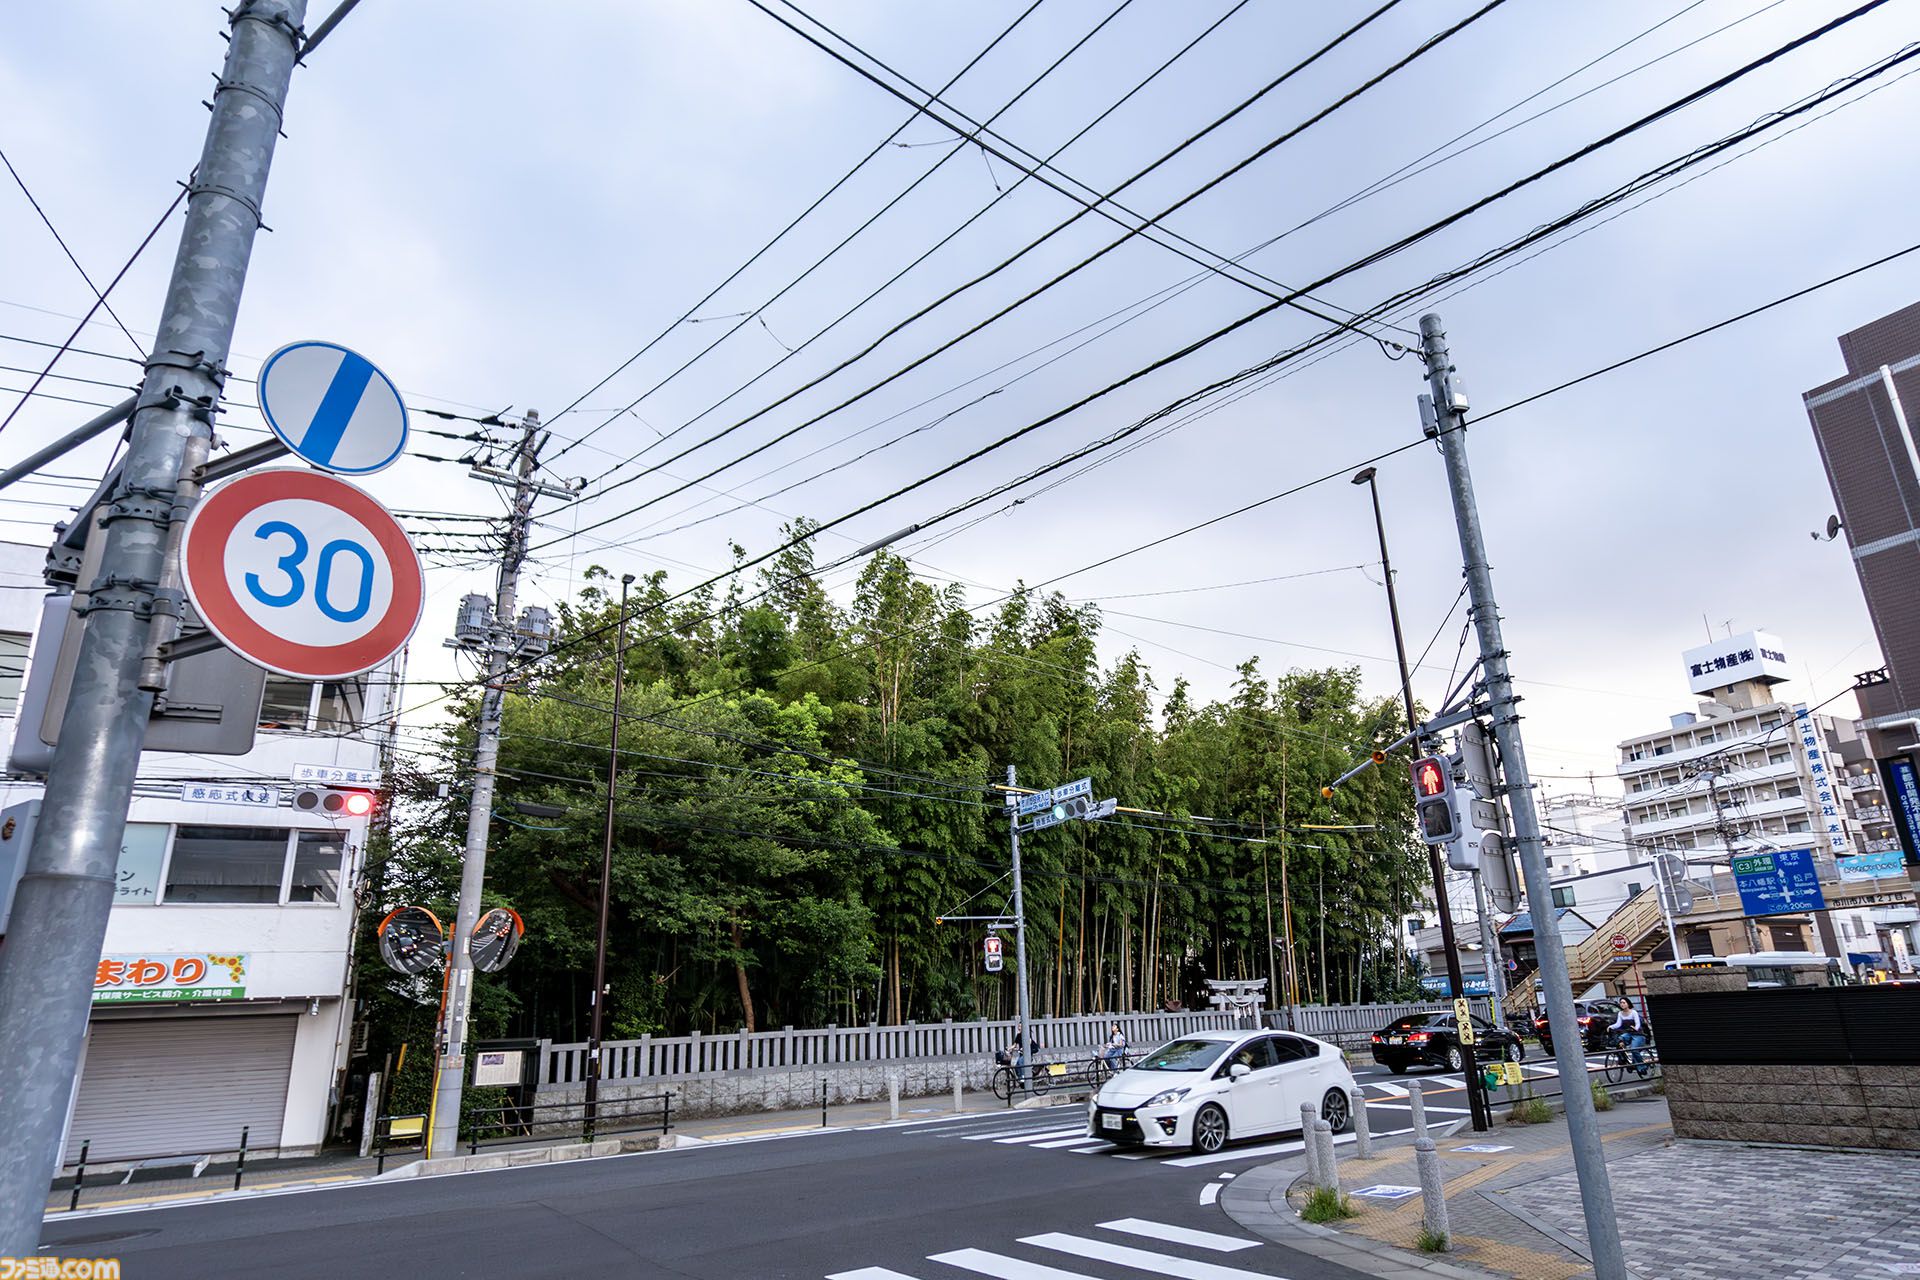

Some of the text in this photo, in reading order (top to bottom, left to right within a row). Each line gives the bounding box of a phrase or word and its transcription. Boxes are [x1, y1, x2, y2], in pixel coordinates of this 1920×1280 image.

[244, 520, 375, 623] 30
[301, 767, 373, 783] 歩車分離式
[191, 787, 270, 804] 感応式信号
[1779, 852, 1800, 861] 東京
[1739, 876, 1777, 888] 本八幡駅
[1793, 872, 1814, 882] 松戸
[94, 957, 207, 986] まわり
